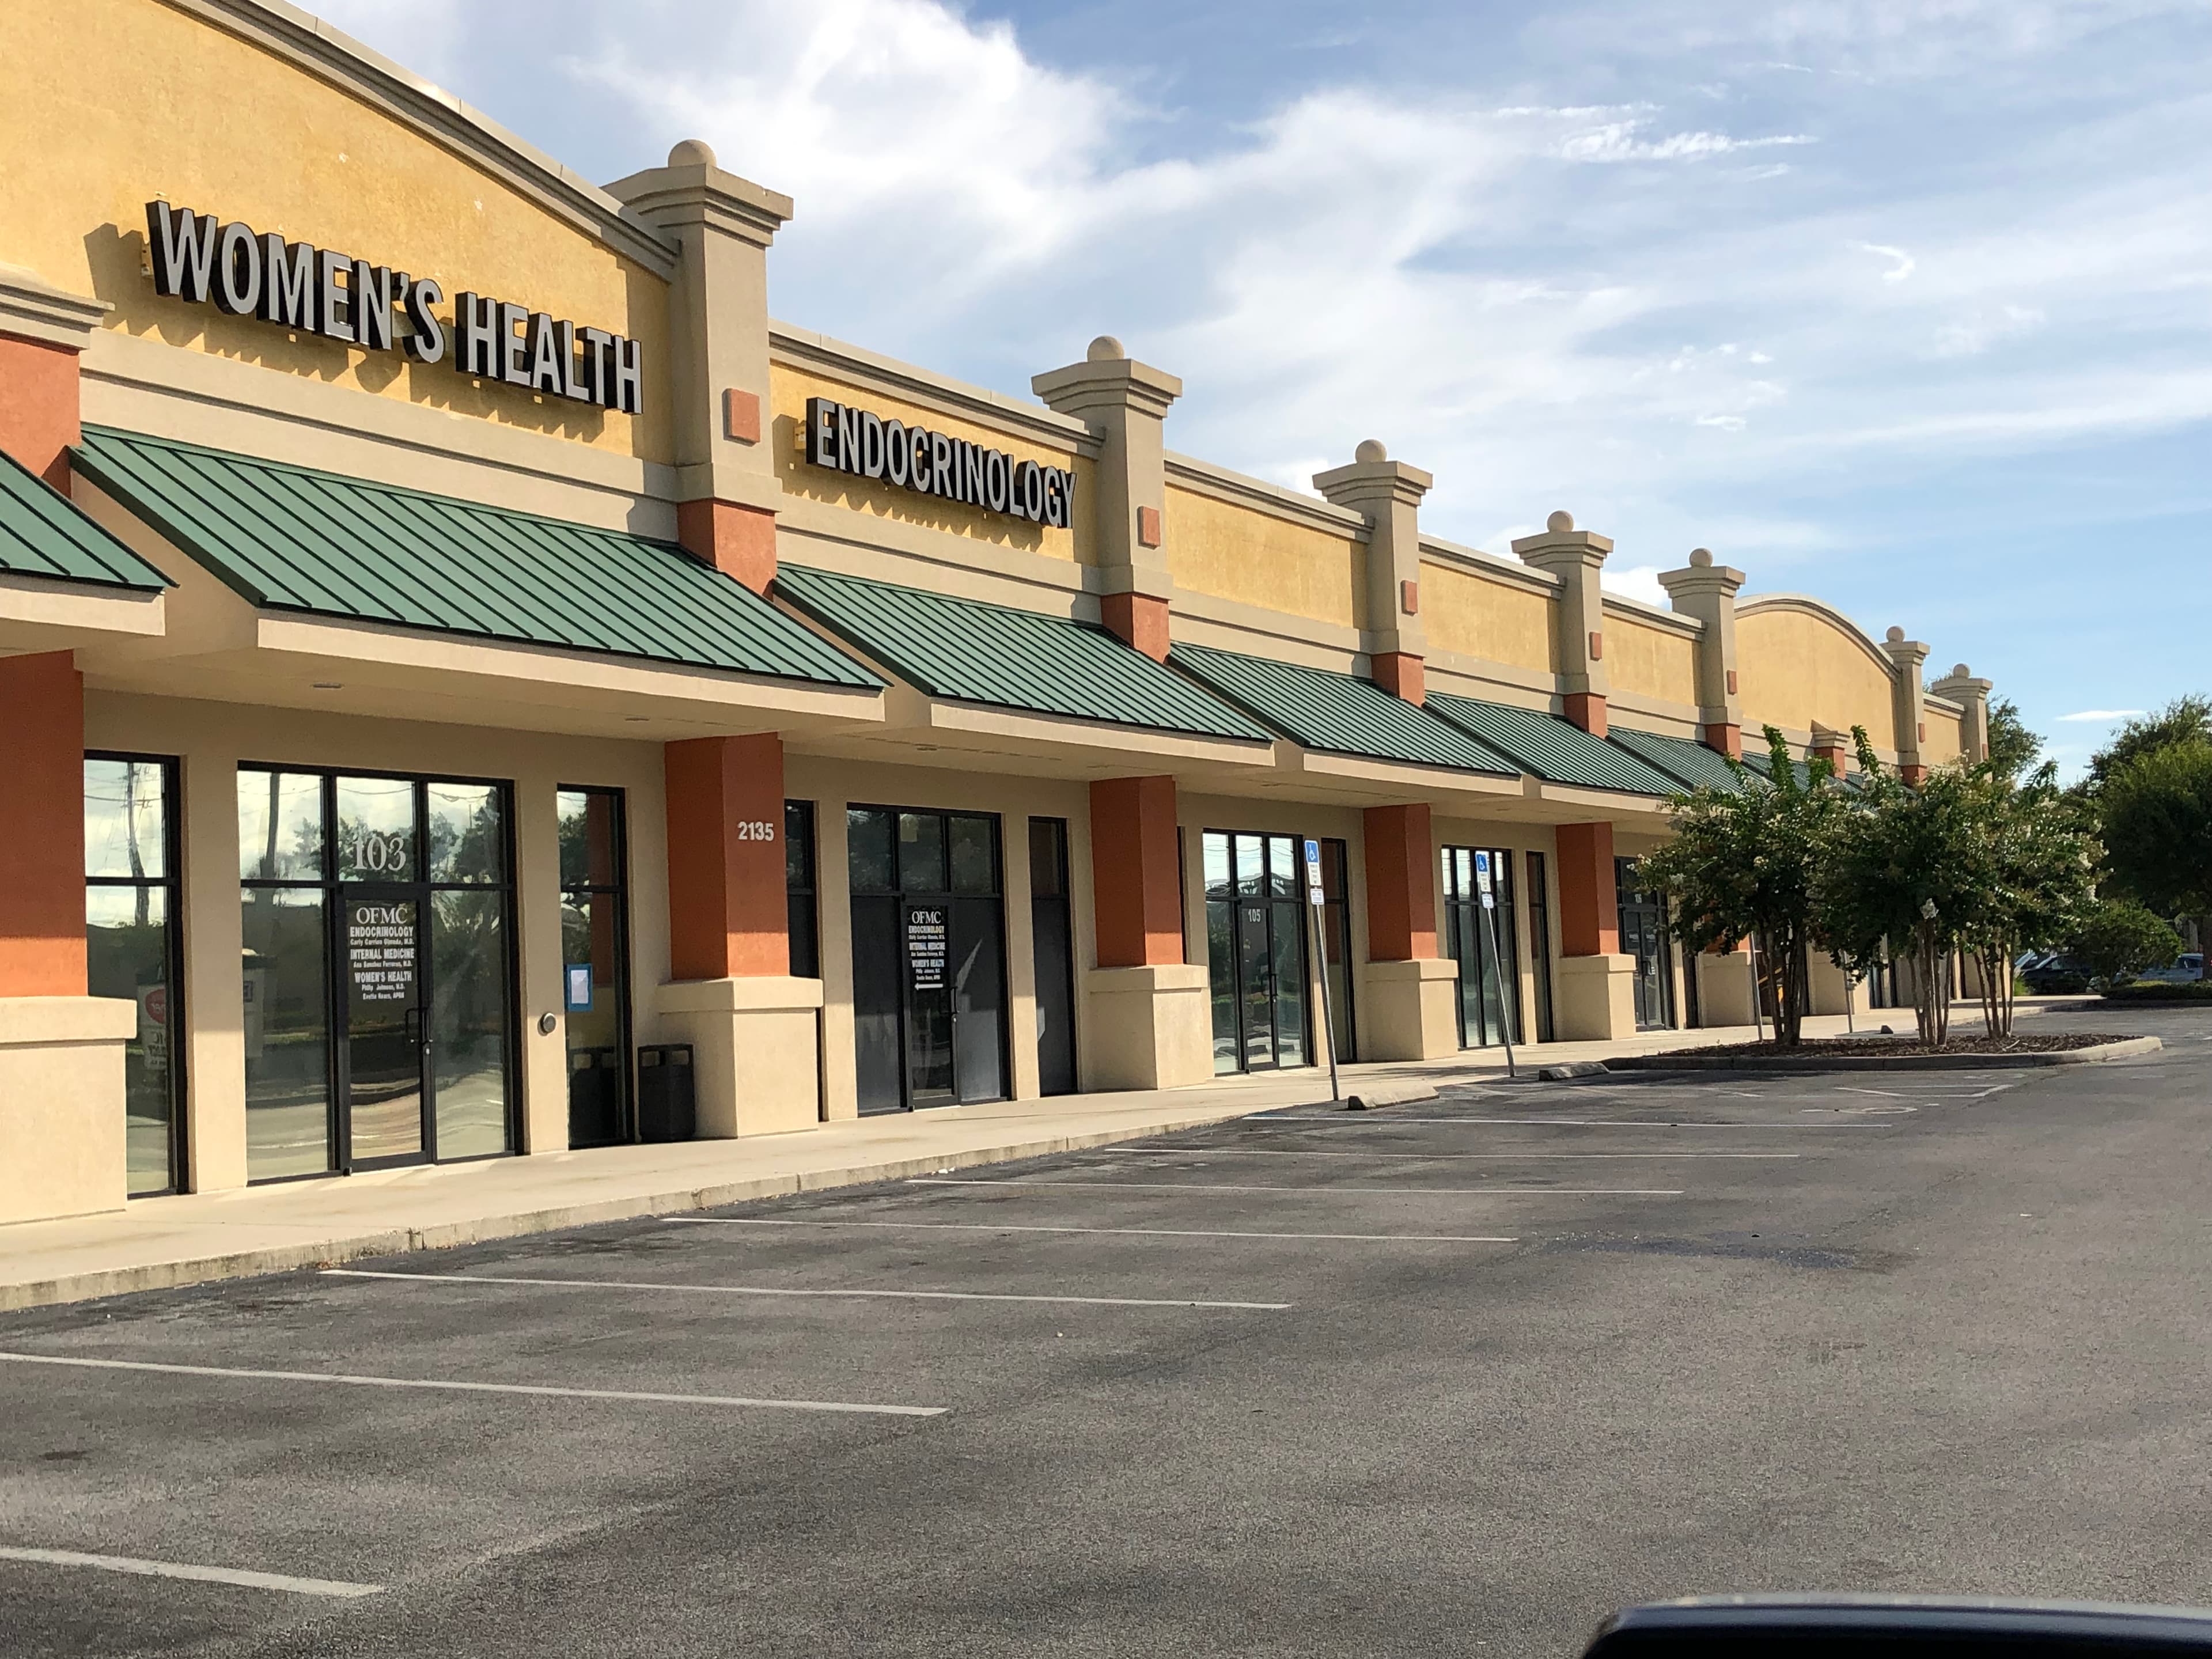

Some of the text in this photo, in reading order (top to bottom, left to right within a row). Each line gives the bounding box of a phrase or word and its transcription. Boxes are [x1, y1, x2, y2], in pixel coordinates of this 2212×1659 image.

[146, 200, 642, 414] WOMEN'S HEALTH
[807, 397, 1077, 528] ENDOCRINOLOGY
[737, 821, 774, 841] 2135
[353, 836, 407, 871] 103
[355, 907, 408, 925] OFMC
[911, 911, 941, 924] OFMC
[1248, 908, 1261, 922] 105
[350, 926, 414, 937] ENDOCRINOLOGY
[350, 948, 414, 960] INTERNAL MEDICINE
[354, 971, 412, 983] WOMEN'S HEALTH
